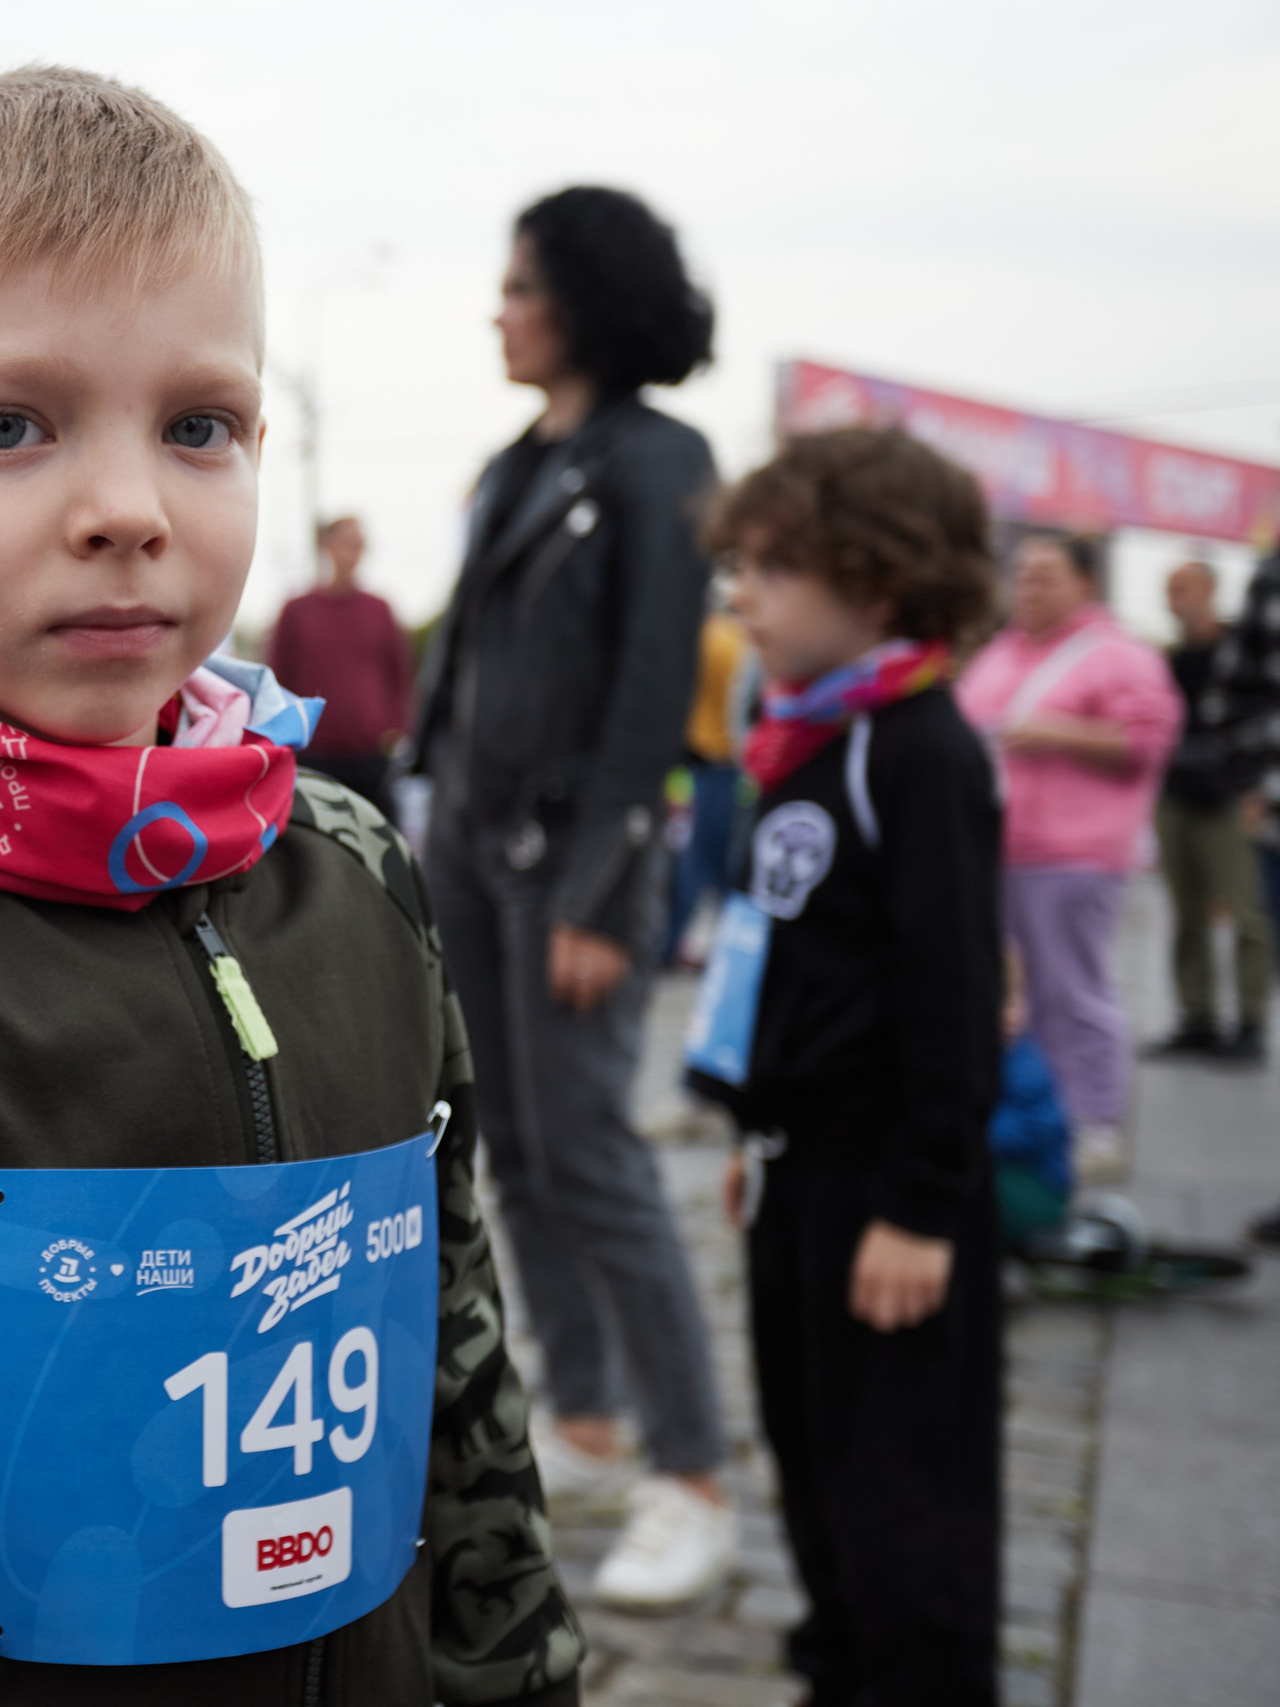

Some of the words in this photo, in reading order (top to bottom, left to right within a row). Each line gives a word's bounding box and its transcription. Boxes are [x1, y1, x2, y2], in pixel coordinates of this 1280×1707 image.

[40, 1239, 95, 1263] ДОБРЫЕ
[229, 1180, 354, 1298] Добрый
[139, 1249, 192, 1269] ДЕТИ
[136, 1268, 195, 1286] НАШИ
[38, 1278, 98, 1303] ПРОЕКТЫ
[163, 1325, 380, 1488] 149
[256, 1524, 334, 1572] BBDO
